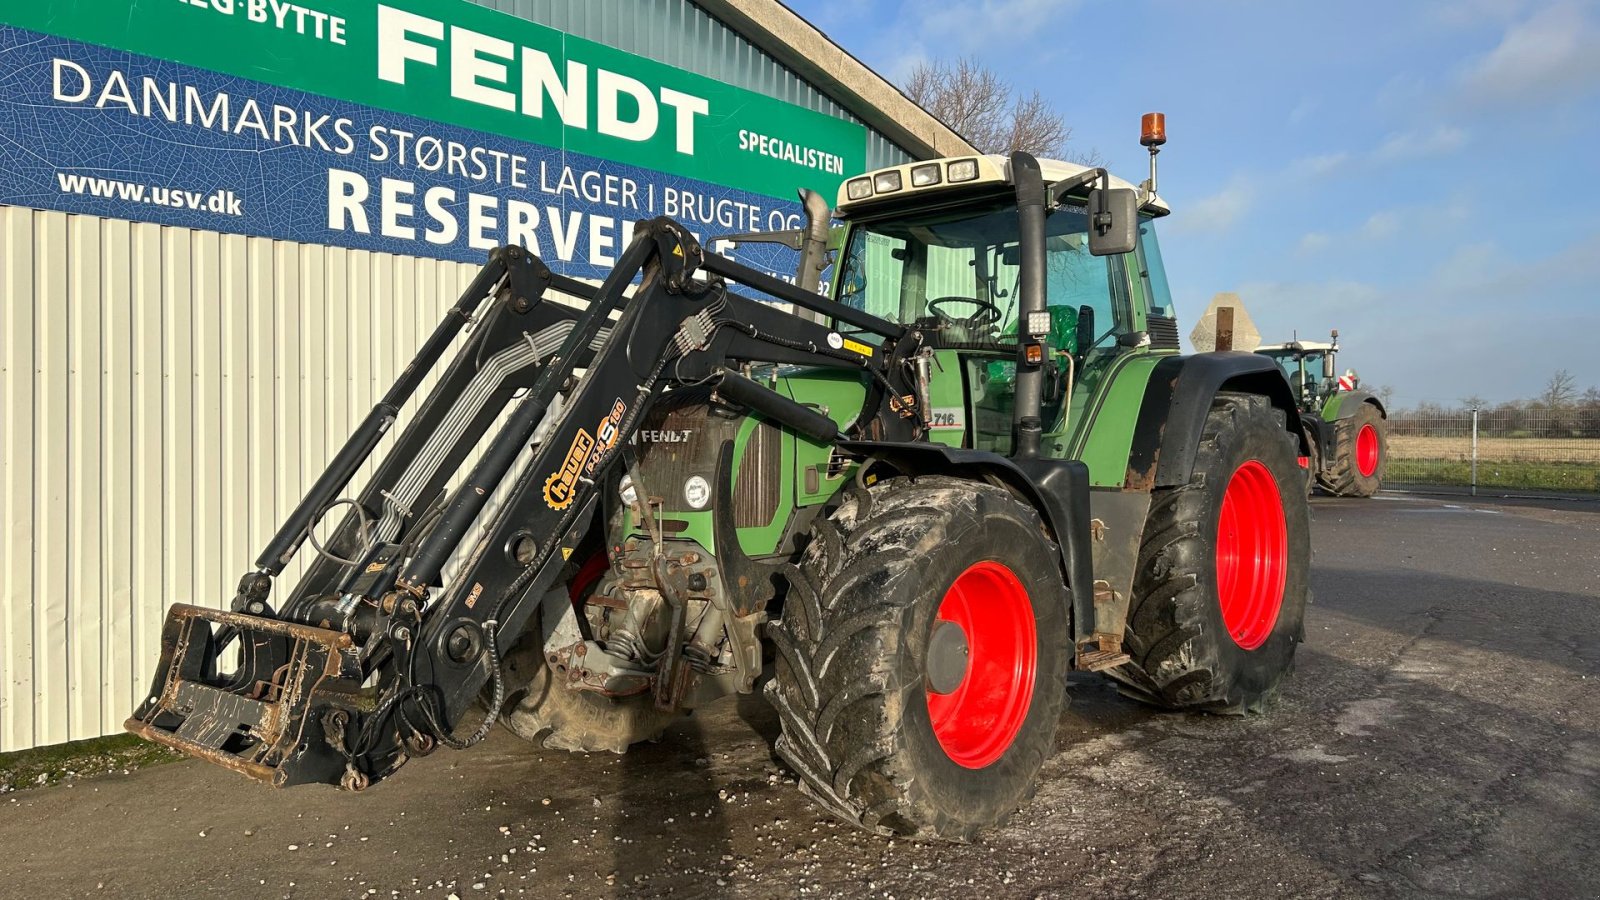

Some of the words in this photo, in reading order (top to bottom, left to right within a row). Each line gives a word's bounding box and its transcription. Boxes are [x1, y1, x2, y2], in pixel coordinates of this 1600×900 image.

[378, 4, 709, 156] FENDT
[53, 58, 354, 155] DANMARKS
[369, 126, 527, 189] STØRSTE
[540, 160, 638, 211] LAGER
[648, 183, 653, 213] I
[664, 187, 761, 233] BRUGTE
[768, 210, 801, 232] OG
[739, 130, 844, 176] SPECIALISTEN
[57, 173, 242, 217] www.usv.dk
[641, 430, 692, 443] FENDT
[934, 413, 955, 426] 716
